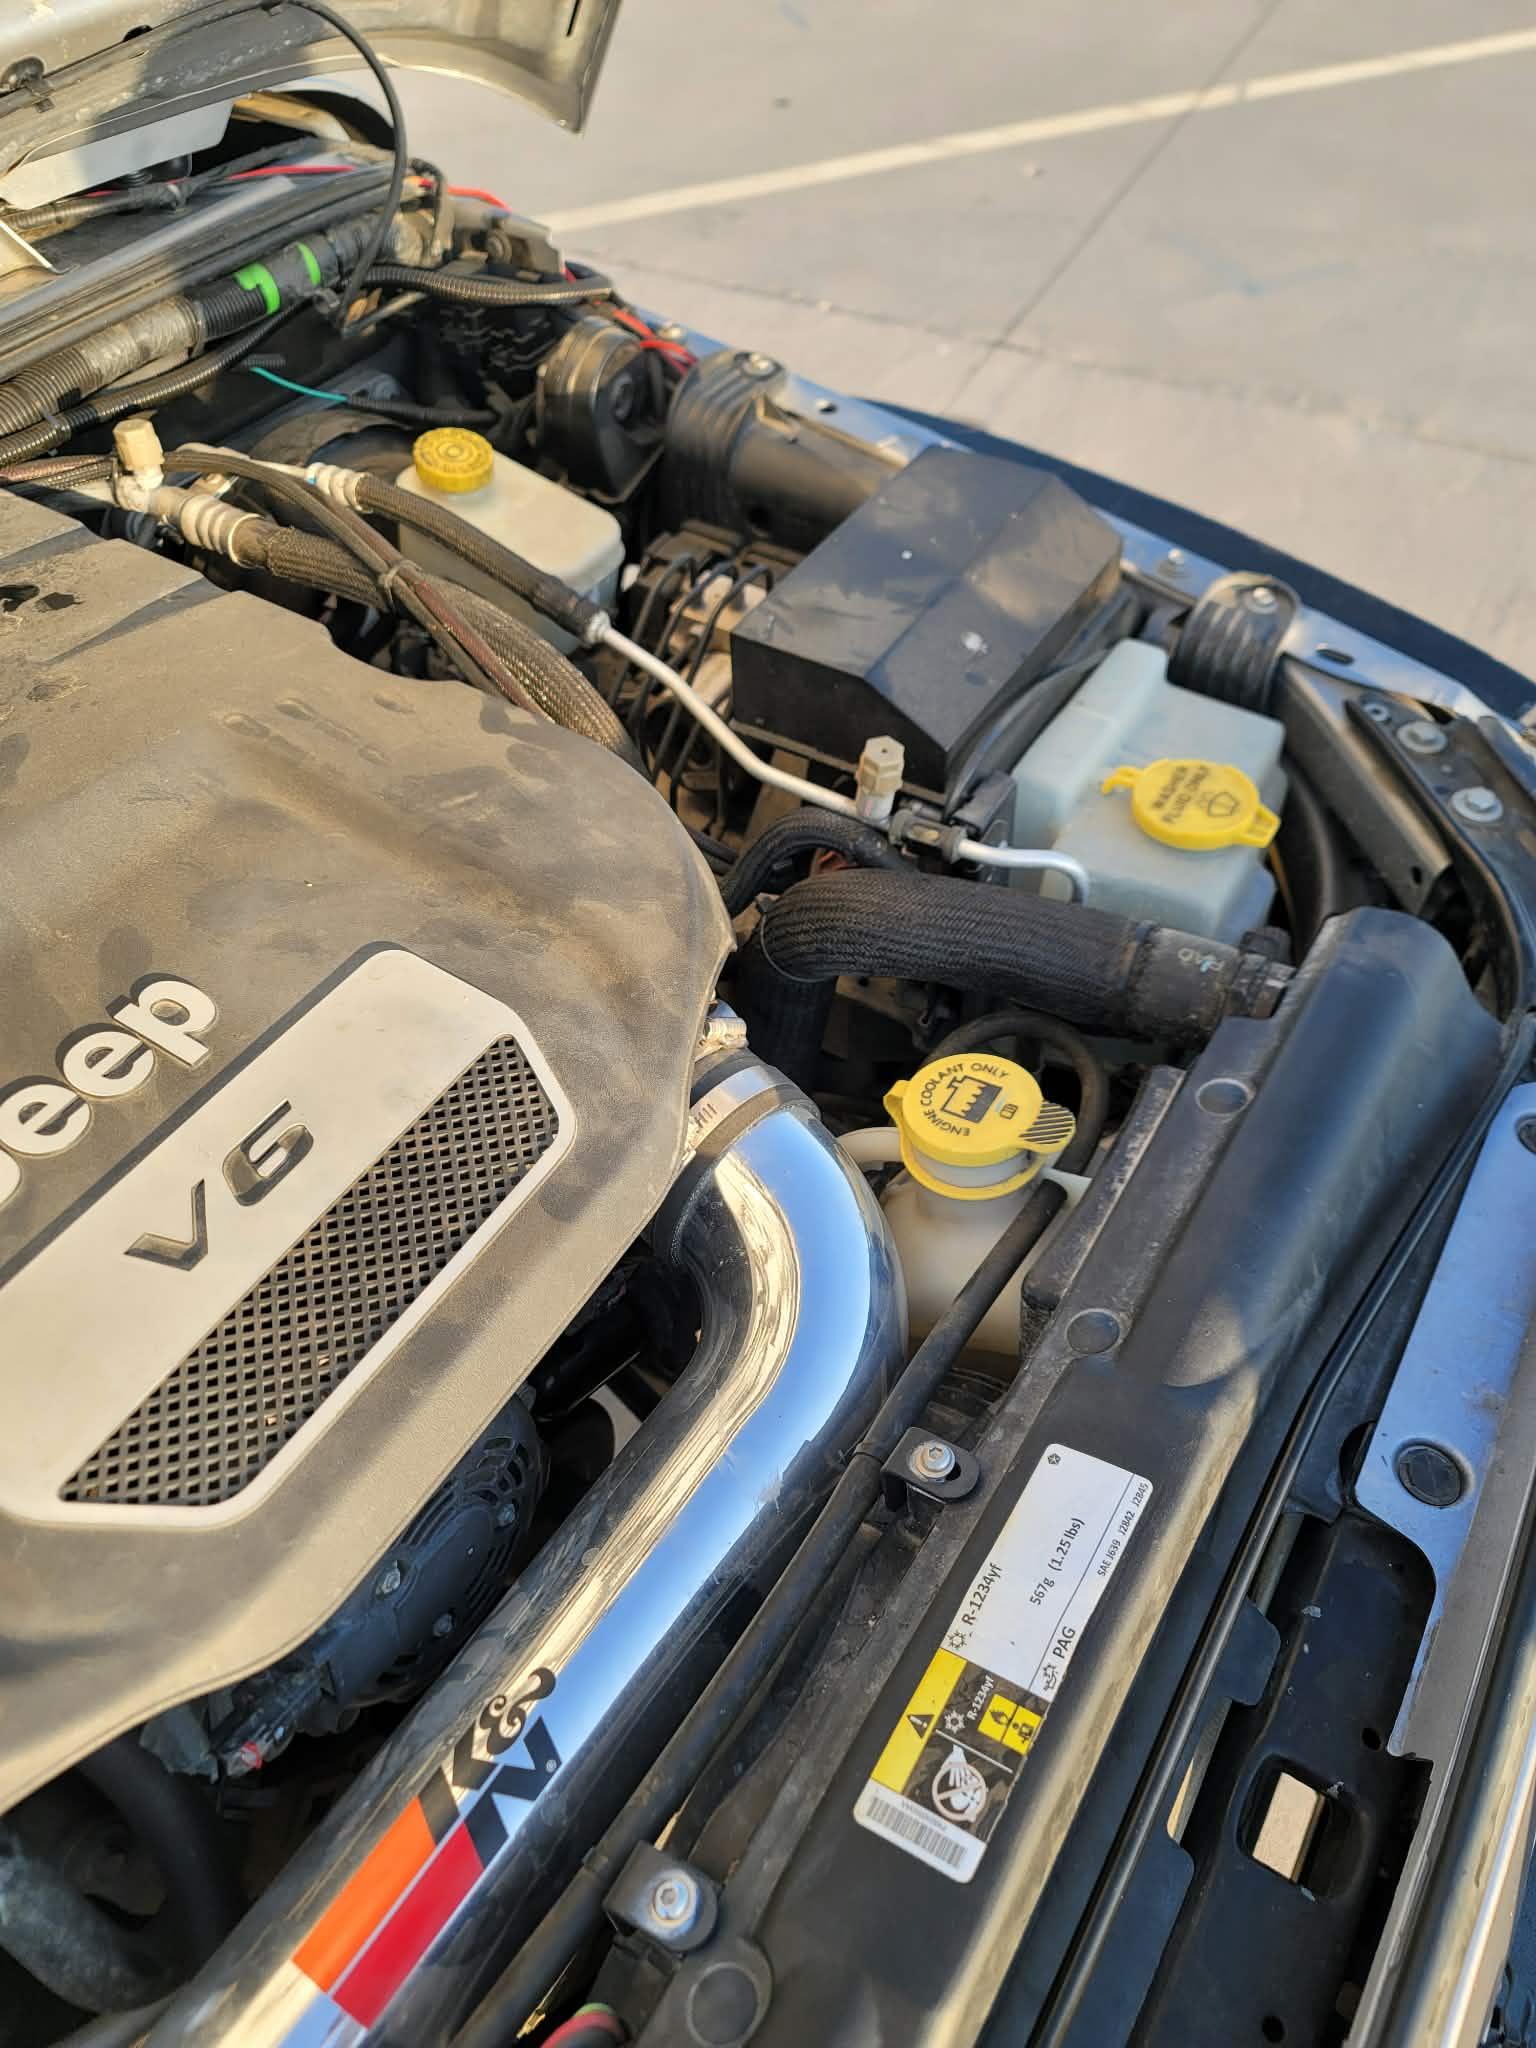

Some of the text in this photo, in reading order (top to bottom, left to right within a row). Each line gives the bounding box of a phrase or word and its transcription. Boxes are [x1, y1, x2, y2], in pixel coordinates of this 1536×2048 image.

[1153, 766, 1188, 809] WASHER
[919, 1062, 1010, 1137] ENGINE COOLANT ONLY
[123, 1098, 315, 1272] V6
[1029, 1517, 1086, 1606] 567g (1.25 lbs)
[1097, 1481, 1149, 1577] SAE J639 J2842 J2845
[961, 1562, 1002, 1626] R-1234yf
[1052, 1626, 1076, 1660] PAG
[966, 1674, 994, 1721] R-1234yf
